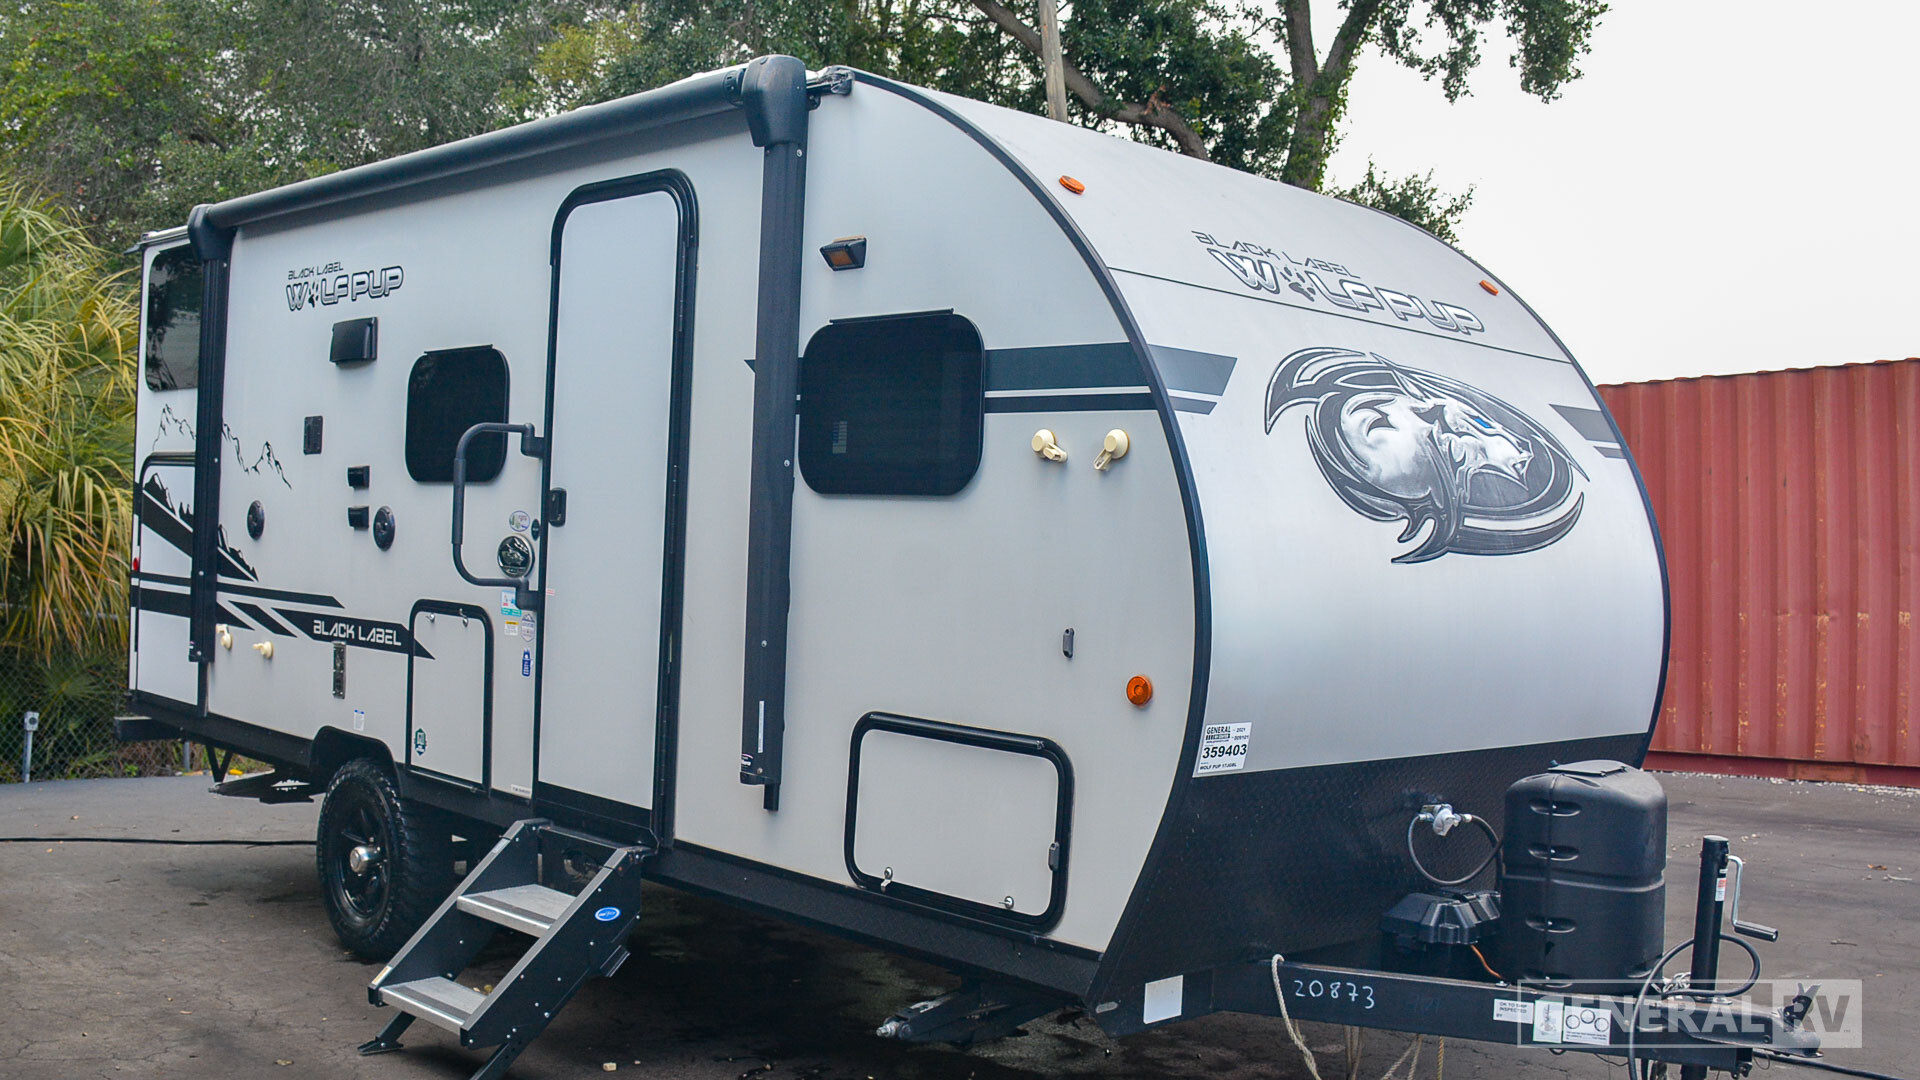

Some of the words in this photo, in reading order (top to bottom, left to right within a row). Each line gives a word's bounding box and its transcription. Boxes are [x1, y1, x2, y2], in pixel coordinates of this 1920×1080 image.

[1191, 230, 1280, 260] BLACK
[1282, 251, 1361, 279] LABEL
[288, 267, 314, 280] BLACK
[316, 262, 344, 275] LABEL
[351, 265, 404, 301] PUP
[1374, 287, 1485, 336] PUP
[313, 620, 355, 639] BLACK
[358, 626, 402, 646] LABEL
[1206, 726, 1231, 734] GENERAL
[1202, 744, 1247, 759] 359403
[1294, 980, 1375, 1009] 20873
